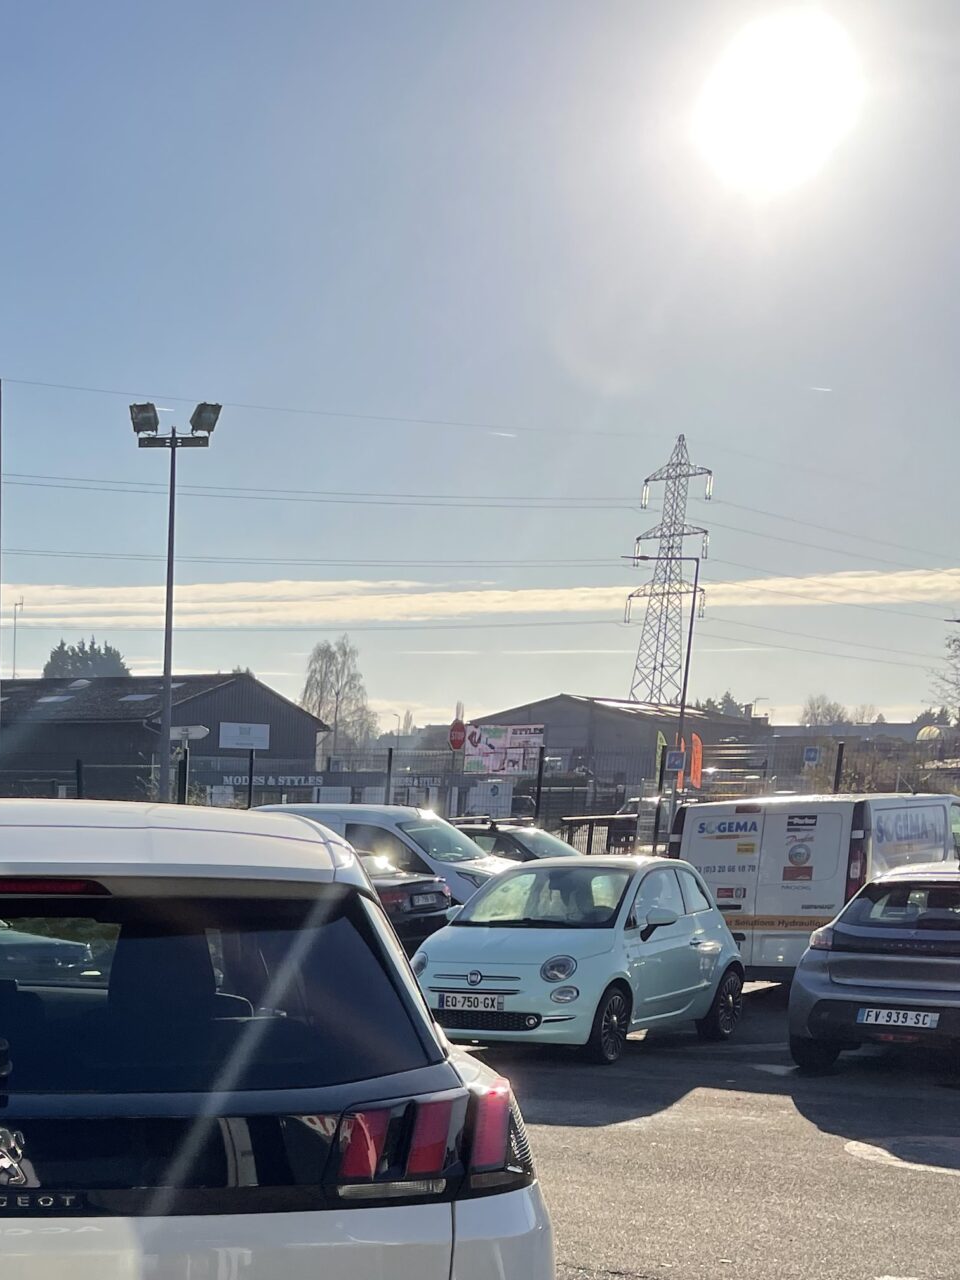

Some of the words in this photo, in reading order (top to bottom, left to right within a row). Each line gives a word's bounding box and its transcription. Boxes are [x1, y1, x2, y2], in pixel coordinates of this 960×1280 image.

[451, 730, 465, 739] STOP
[267, 776, 276, 785] &
[278, 776, 323, 785] STYLES
[734, 919, 775, 927] Solutions
